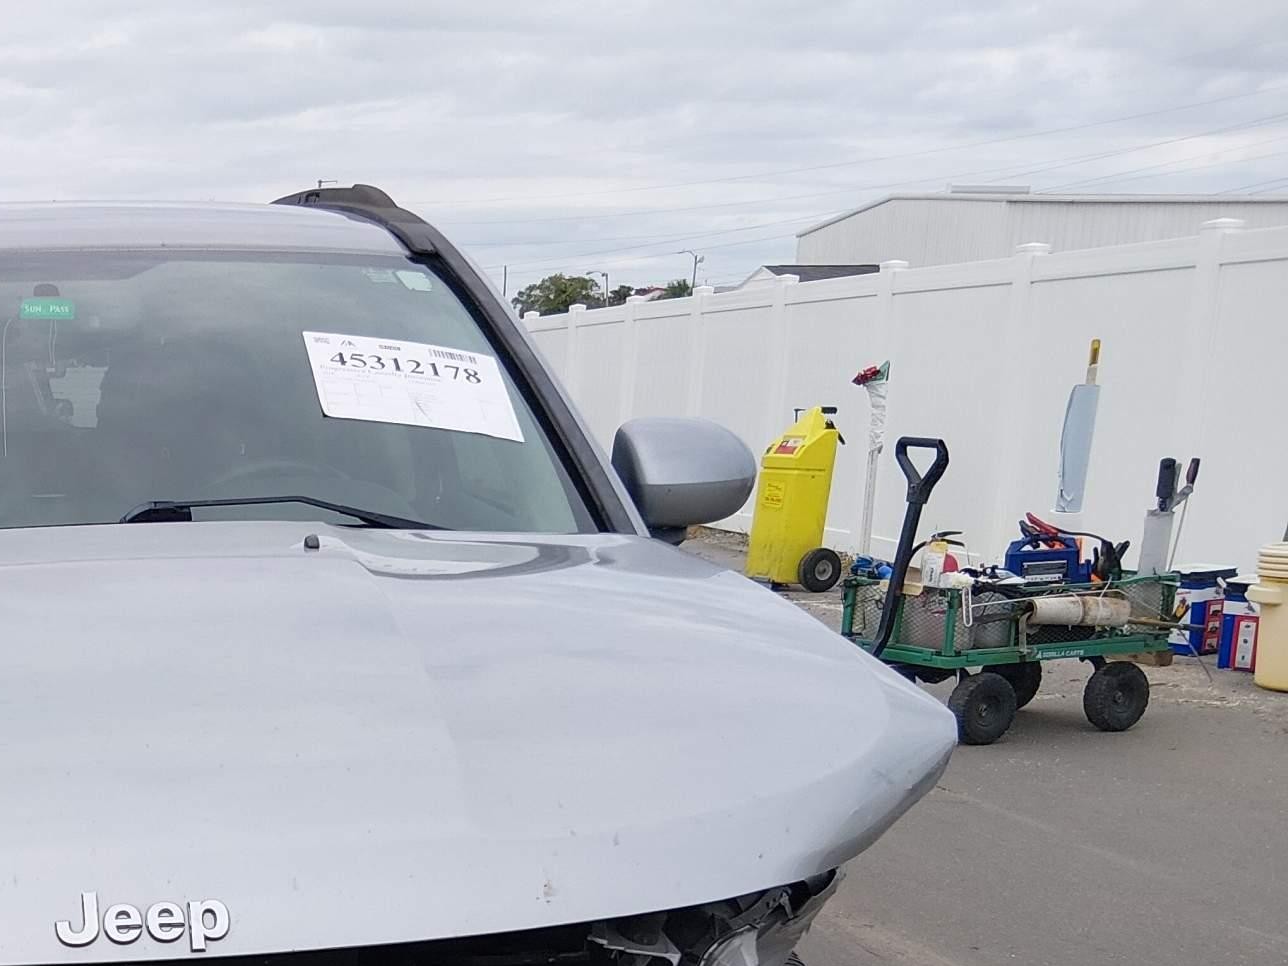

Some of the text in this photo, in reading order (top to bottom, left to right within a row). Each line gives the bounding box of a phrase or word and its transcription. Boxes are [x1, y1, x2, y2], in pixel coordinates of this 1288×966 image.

[23, 303, 70, 313] SUN PASS
[330, 351, 482, 385] 45312178
[54, 890, 231, 953] Jeep
